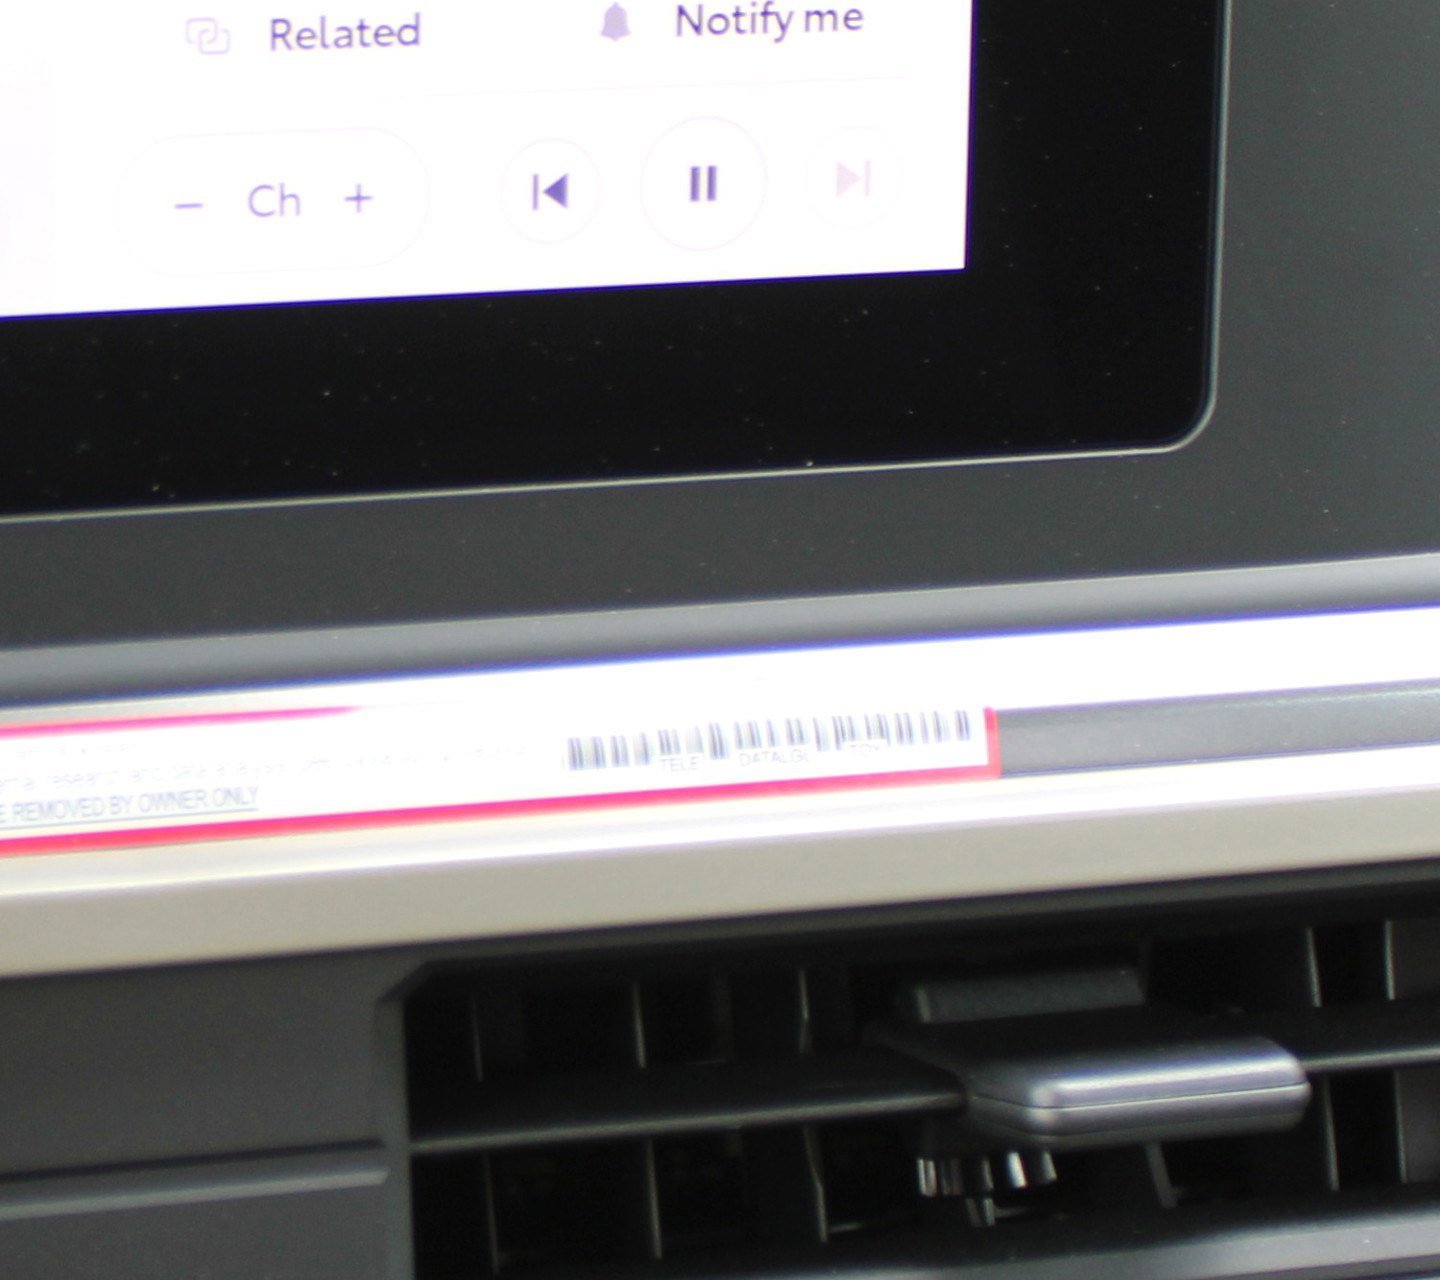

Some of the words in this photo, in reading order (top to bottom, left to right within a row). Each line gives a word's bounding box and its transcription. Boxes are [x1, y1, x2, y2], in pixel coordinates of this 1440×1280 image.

[269, 11, 422, 52] Related
[675, 0, 795, 44] Notify
[803, 7, 864, 33] me
[247, 182, 302, 219] Ch
[13, 796, 106, 823] REMOVED
[110, 792, 134, 816] BY
[138, 788, 208, 814] OWNER
[213, 784, 260, 808] ONLY
